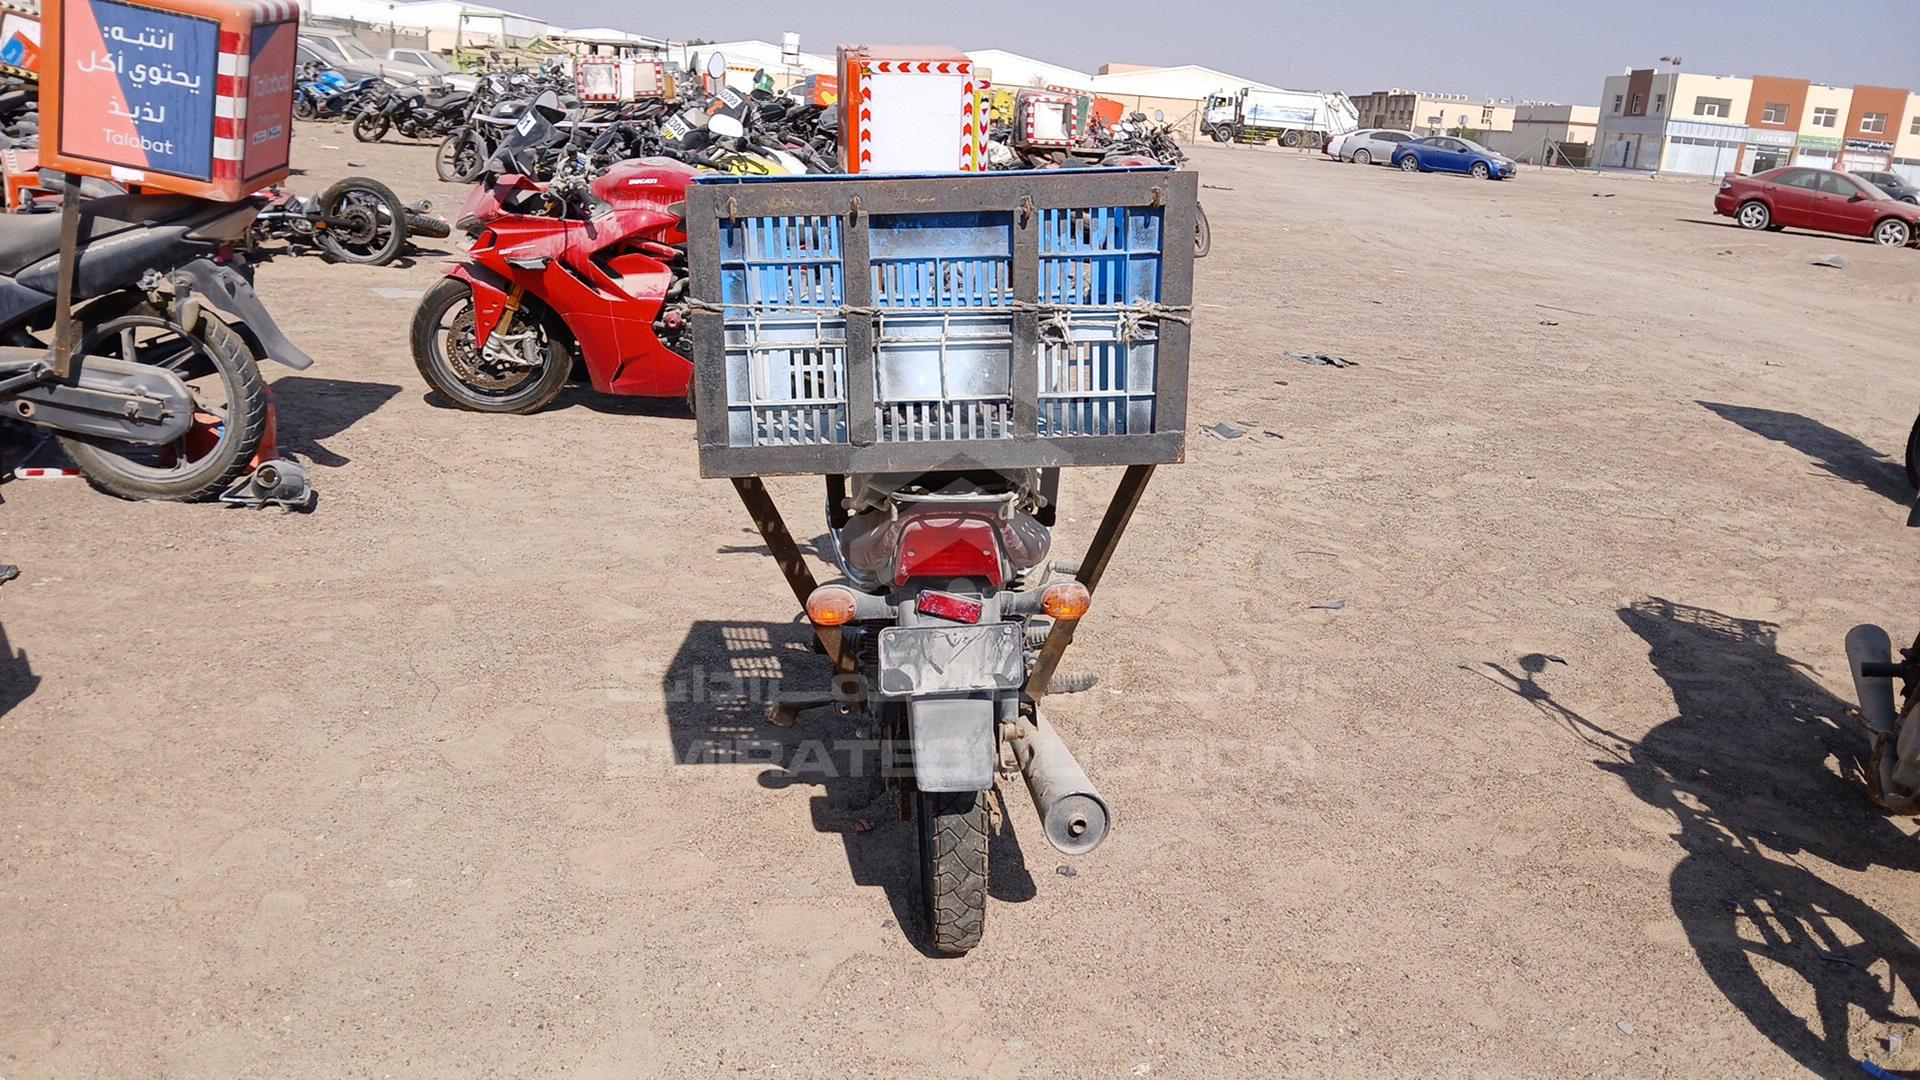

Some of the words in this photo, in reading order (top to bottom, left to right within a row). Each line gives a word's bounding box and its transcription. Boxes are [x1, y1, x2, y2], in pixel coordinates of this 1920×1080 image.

[103, 25, 174, 51] انتبه:
[77, 50, 123, 73] أكل
[128, 63, 200, 94] يحتوي
[107, 96, 165, 124] لذيذ
[103, 128, 173, 155] Talabat
[628, 178, 658, 186] DUCATI
